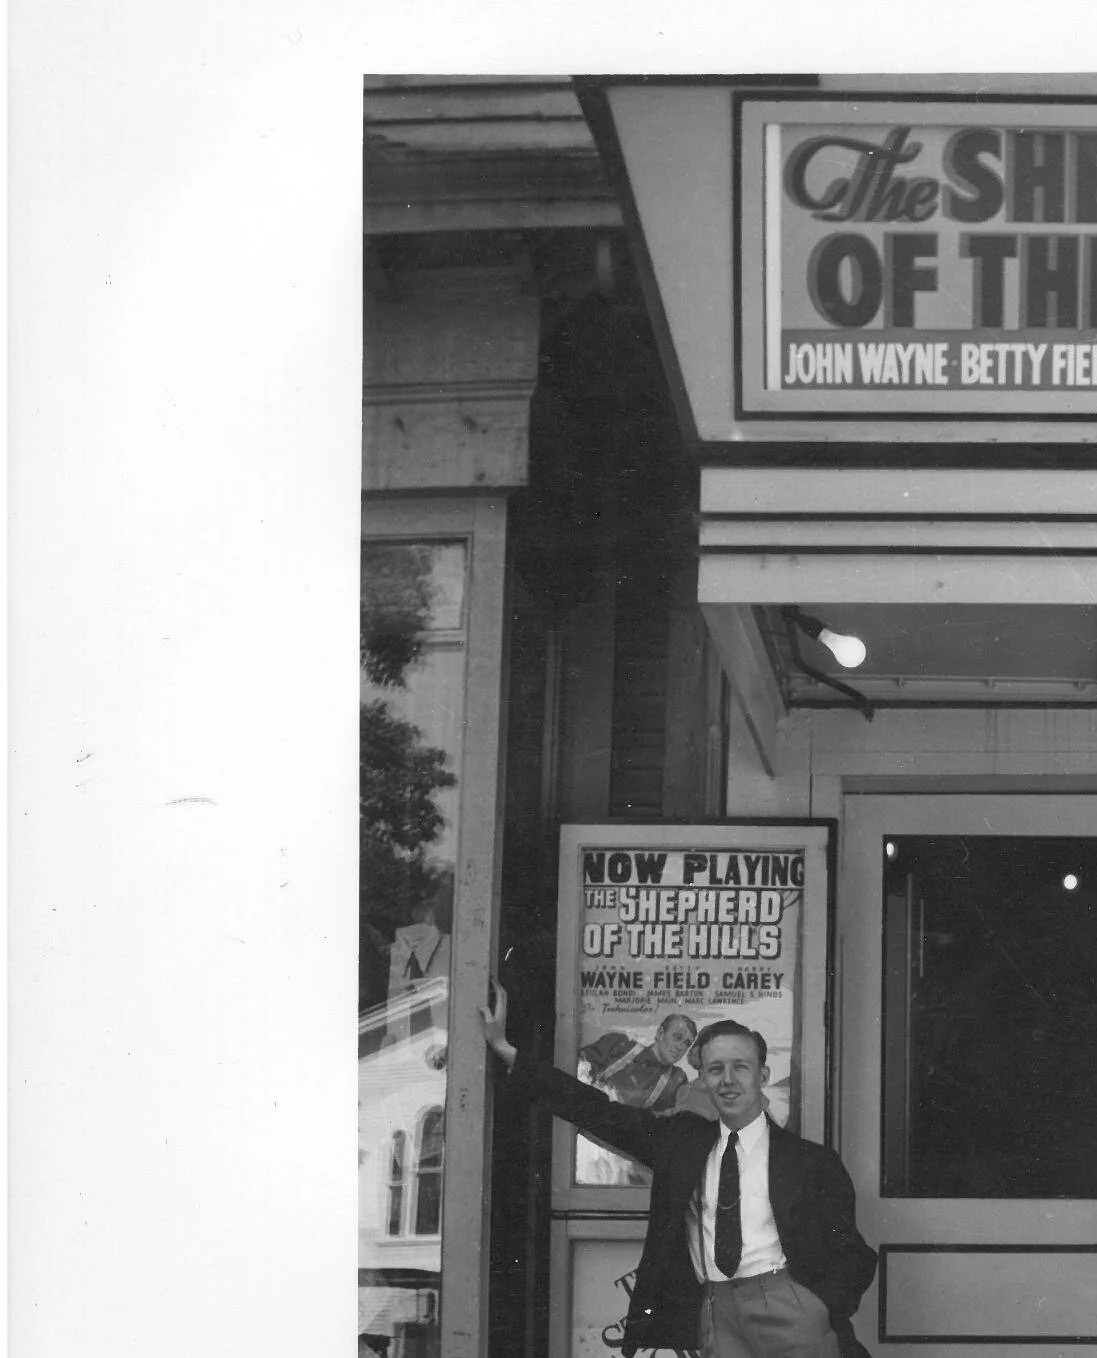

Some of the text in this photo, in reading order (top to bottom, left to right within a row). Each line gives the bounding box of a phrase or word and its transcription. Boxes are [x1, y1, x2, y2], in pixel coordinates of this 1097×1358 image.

[783, 122, 941, 224] The
[806, 232, 938, 329] OF
[785, 343, 852, 386] JOHN
[860, 344, 949, 387] WAYNE
[961, 344, 1046, 387] BETTY
[584, 852, 806, 886] NOW PLAYING
[585, 887, 783, 925] THE SHEPHERD
[583, 923, 782, 960] OF THE HILLS
[580, 971, 785, 990] WAYNE FIELD CAREY
